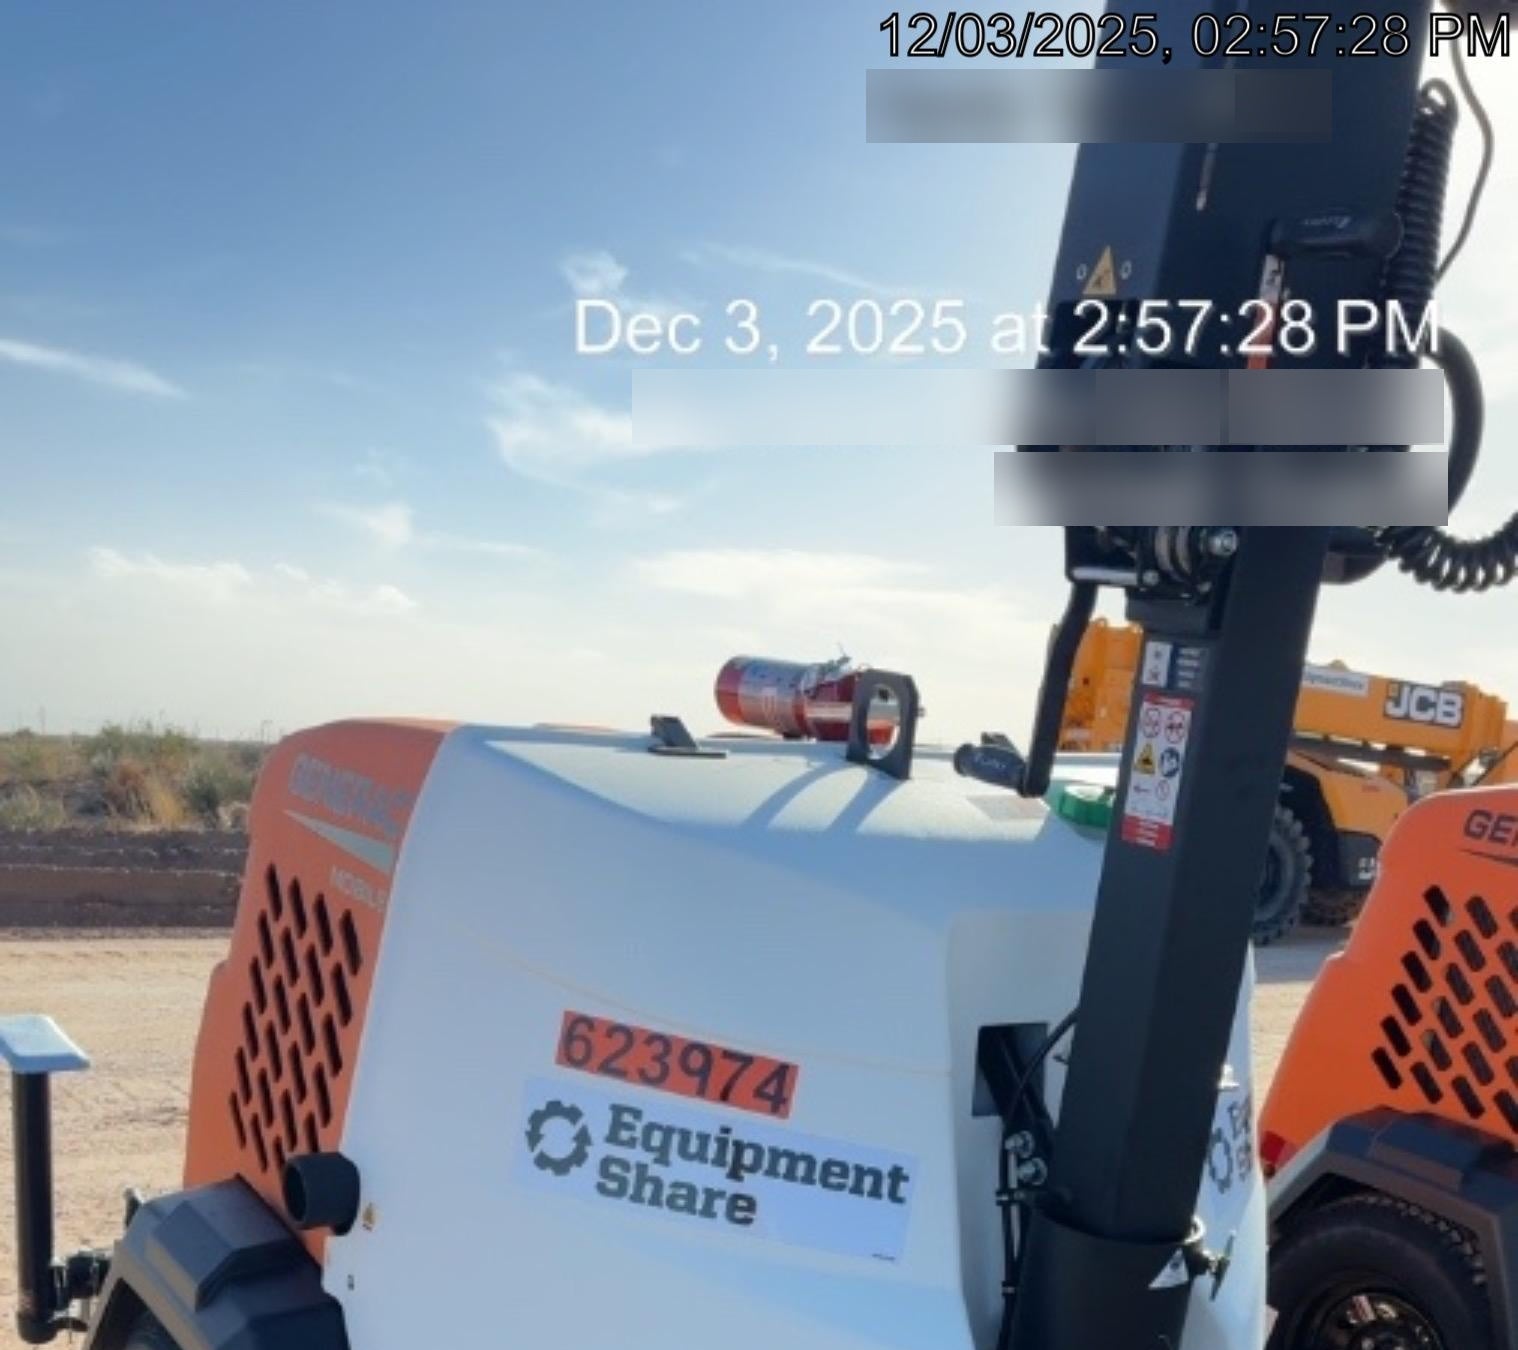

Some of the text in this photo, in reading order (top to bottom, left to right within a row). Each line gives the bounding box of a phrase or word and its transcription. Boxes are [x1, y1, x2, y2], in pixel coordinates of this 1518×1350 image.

[1385, 681, 1464, 727] JCB
[1464, 809, 1518, 847] GE
[560, 1014, 793, 1115] 623974
[604, 1102, 911, 1205] Equipment
[595, 1154, 758, 1227] Share
